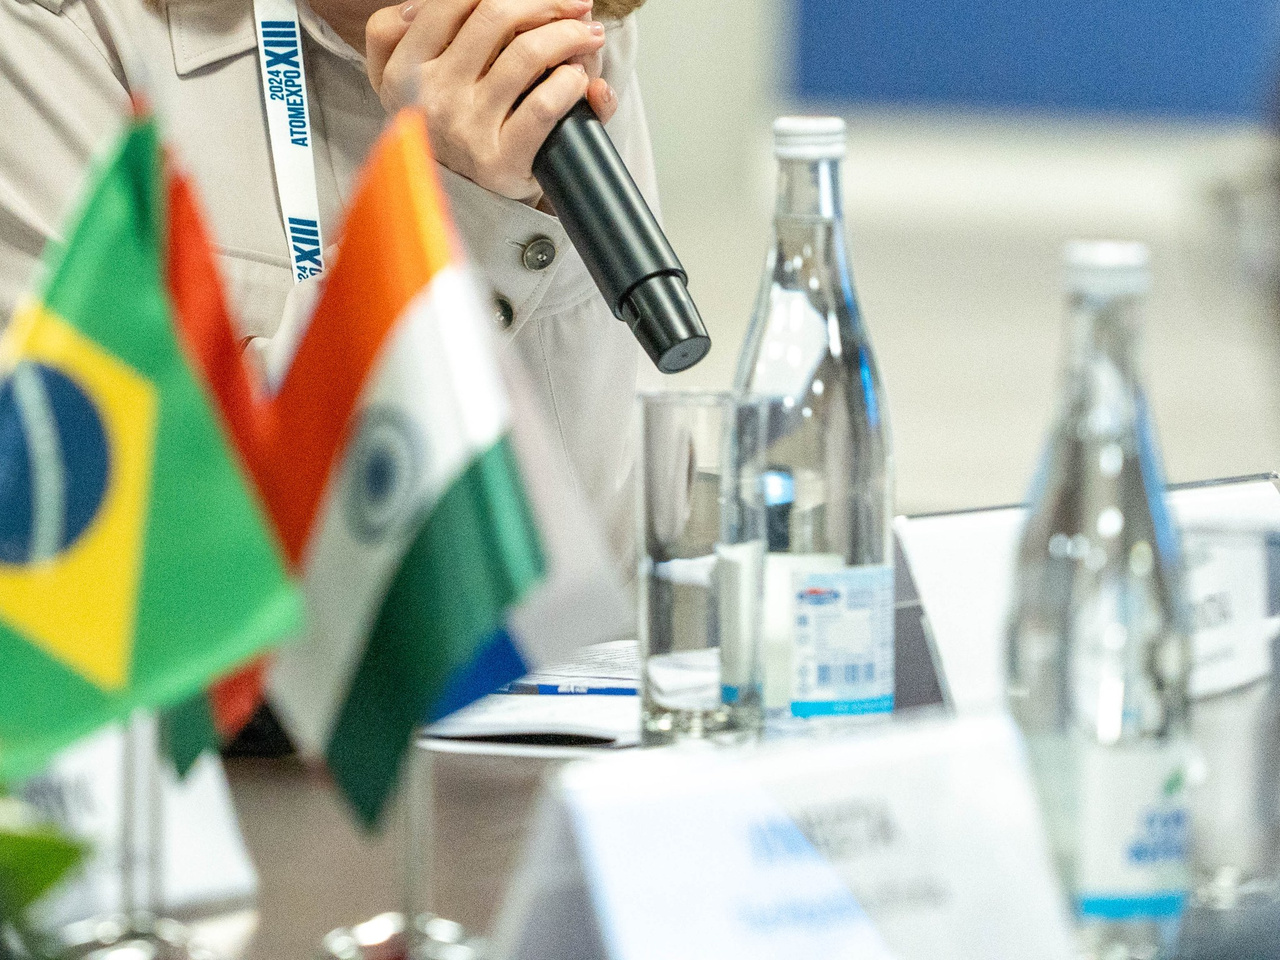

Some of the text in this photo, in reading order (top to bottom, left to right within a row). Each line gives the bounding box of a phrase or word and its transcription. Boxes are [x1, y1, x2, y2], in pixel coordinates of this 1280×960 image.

[261, 20, 300, 69] XIII
[267, 69, 285, 101] 2024
[282, 69, 309, 147] ATOMEXPO
[288, 217, 322, 267] XIII
